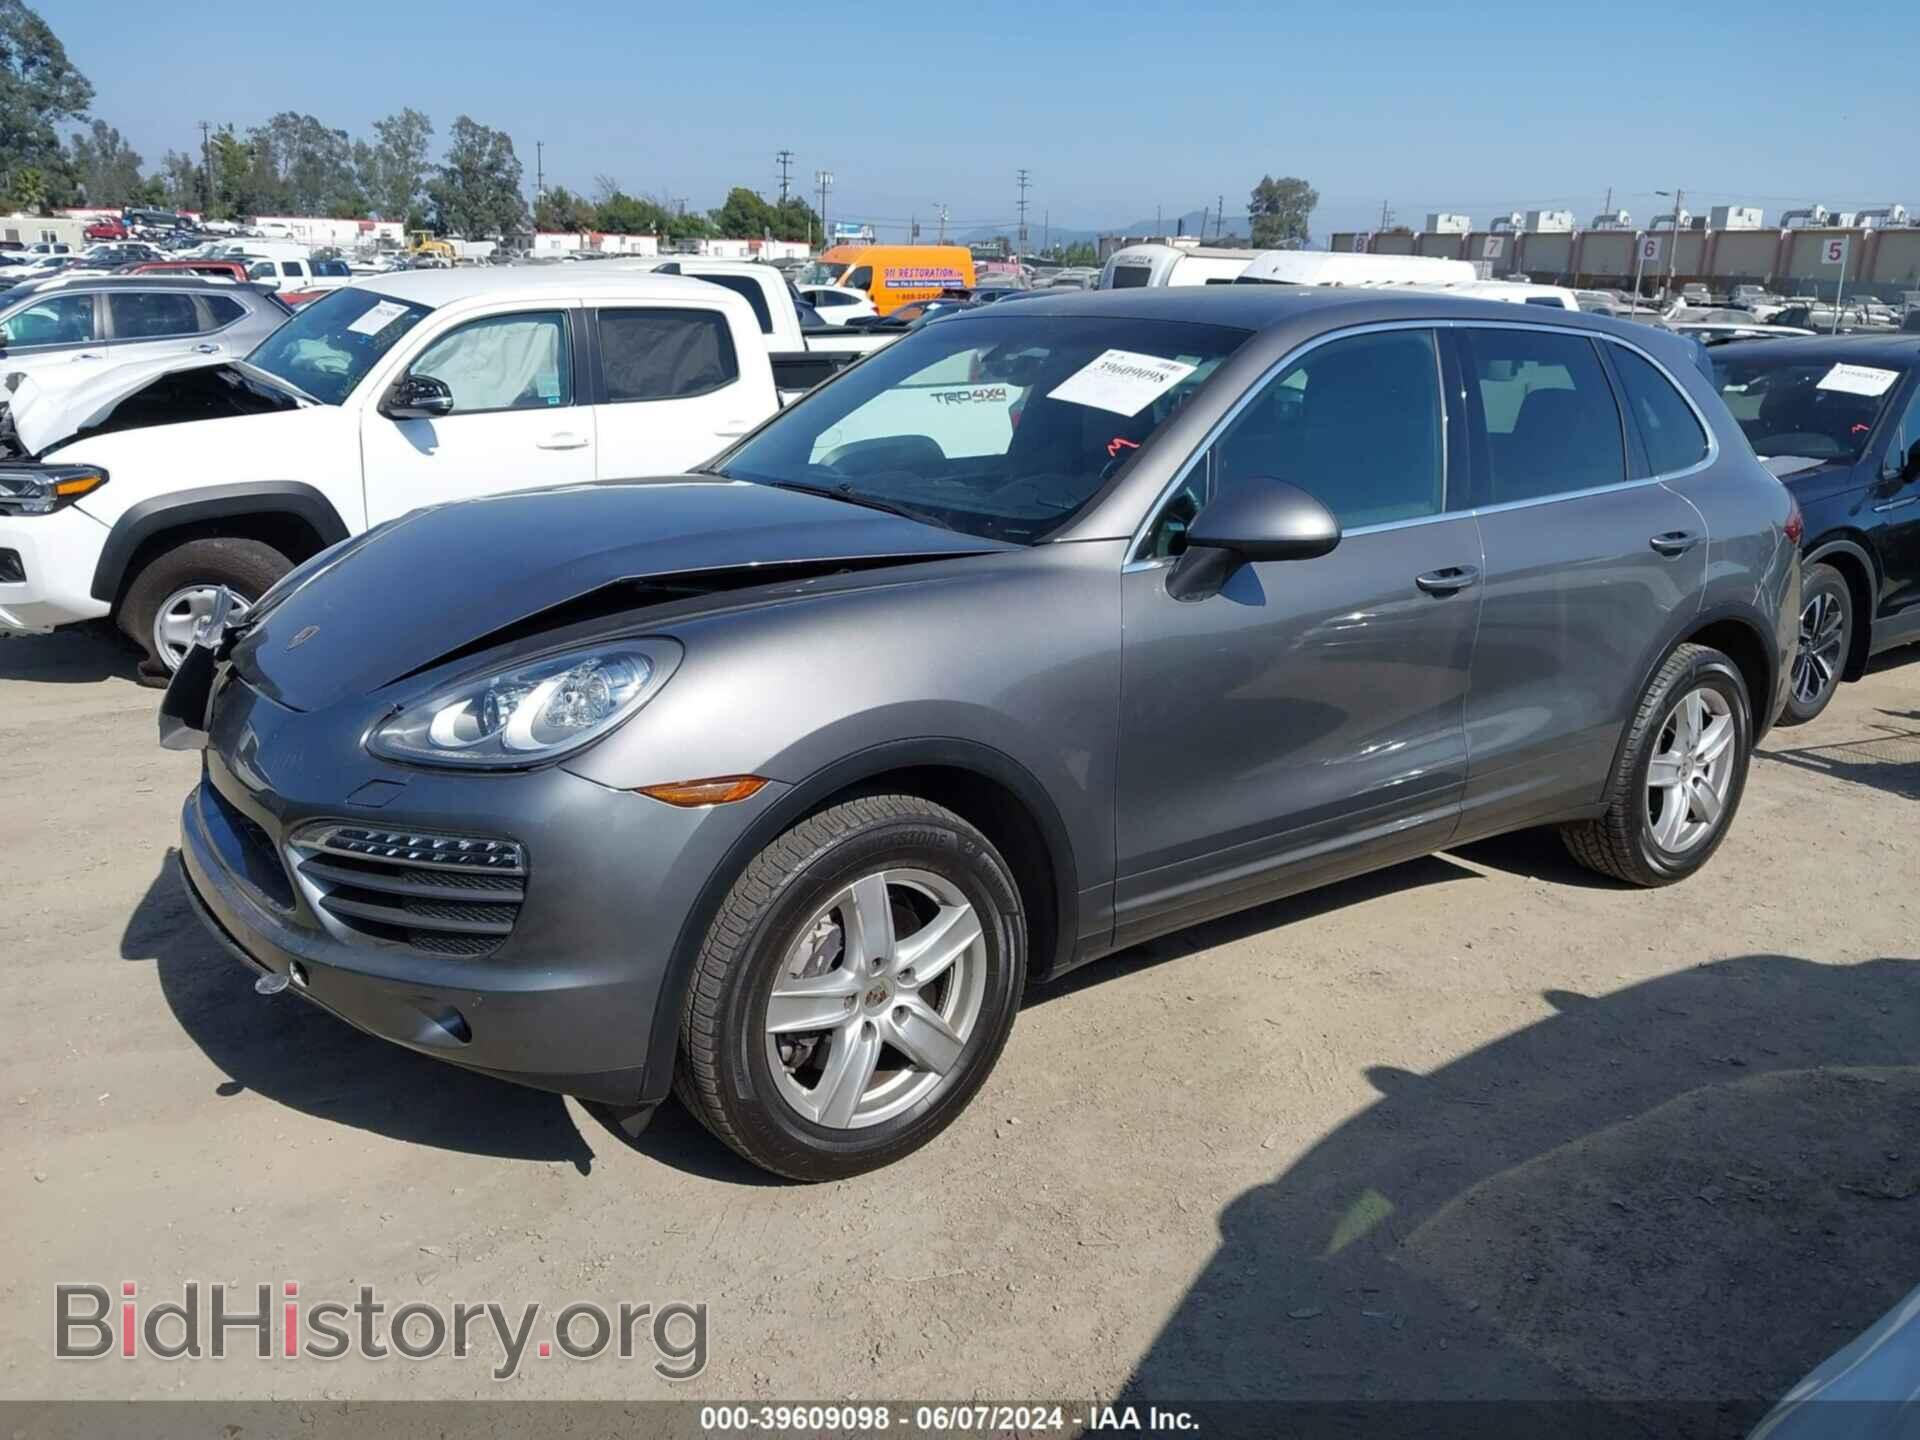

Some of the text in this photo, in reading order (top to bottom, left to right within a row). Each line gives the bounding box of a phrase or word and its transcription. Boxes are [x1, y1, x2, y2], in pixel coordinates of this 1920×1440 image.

[1487, 239, 1496, 255] 7
[1644, 239, 1655, 257] 6
[1828, 242, 1842, 260] 5
[930, 391, 971, 405] TRD
